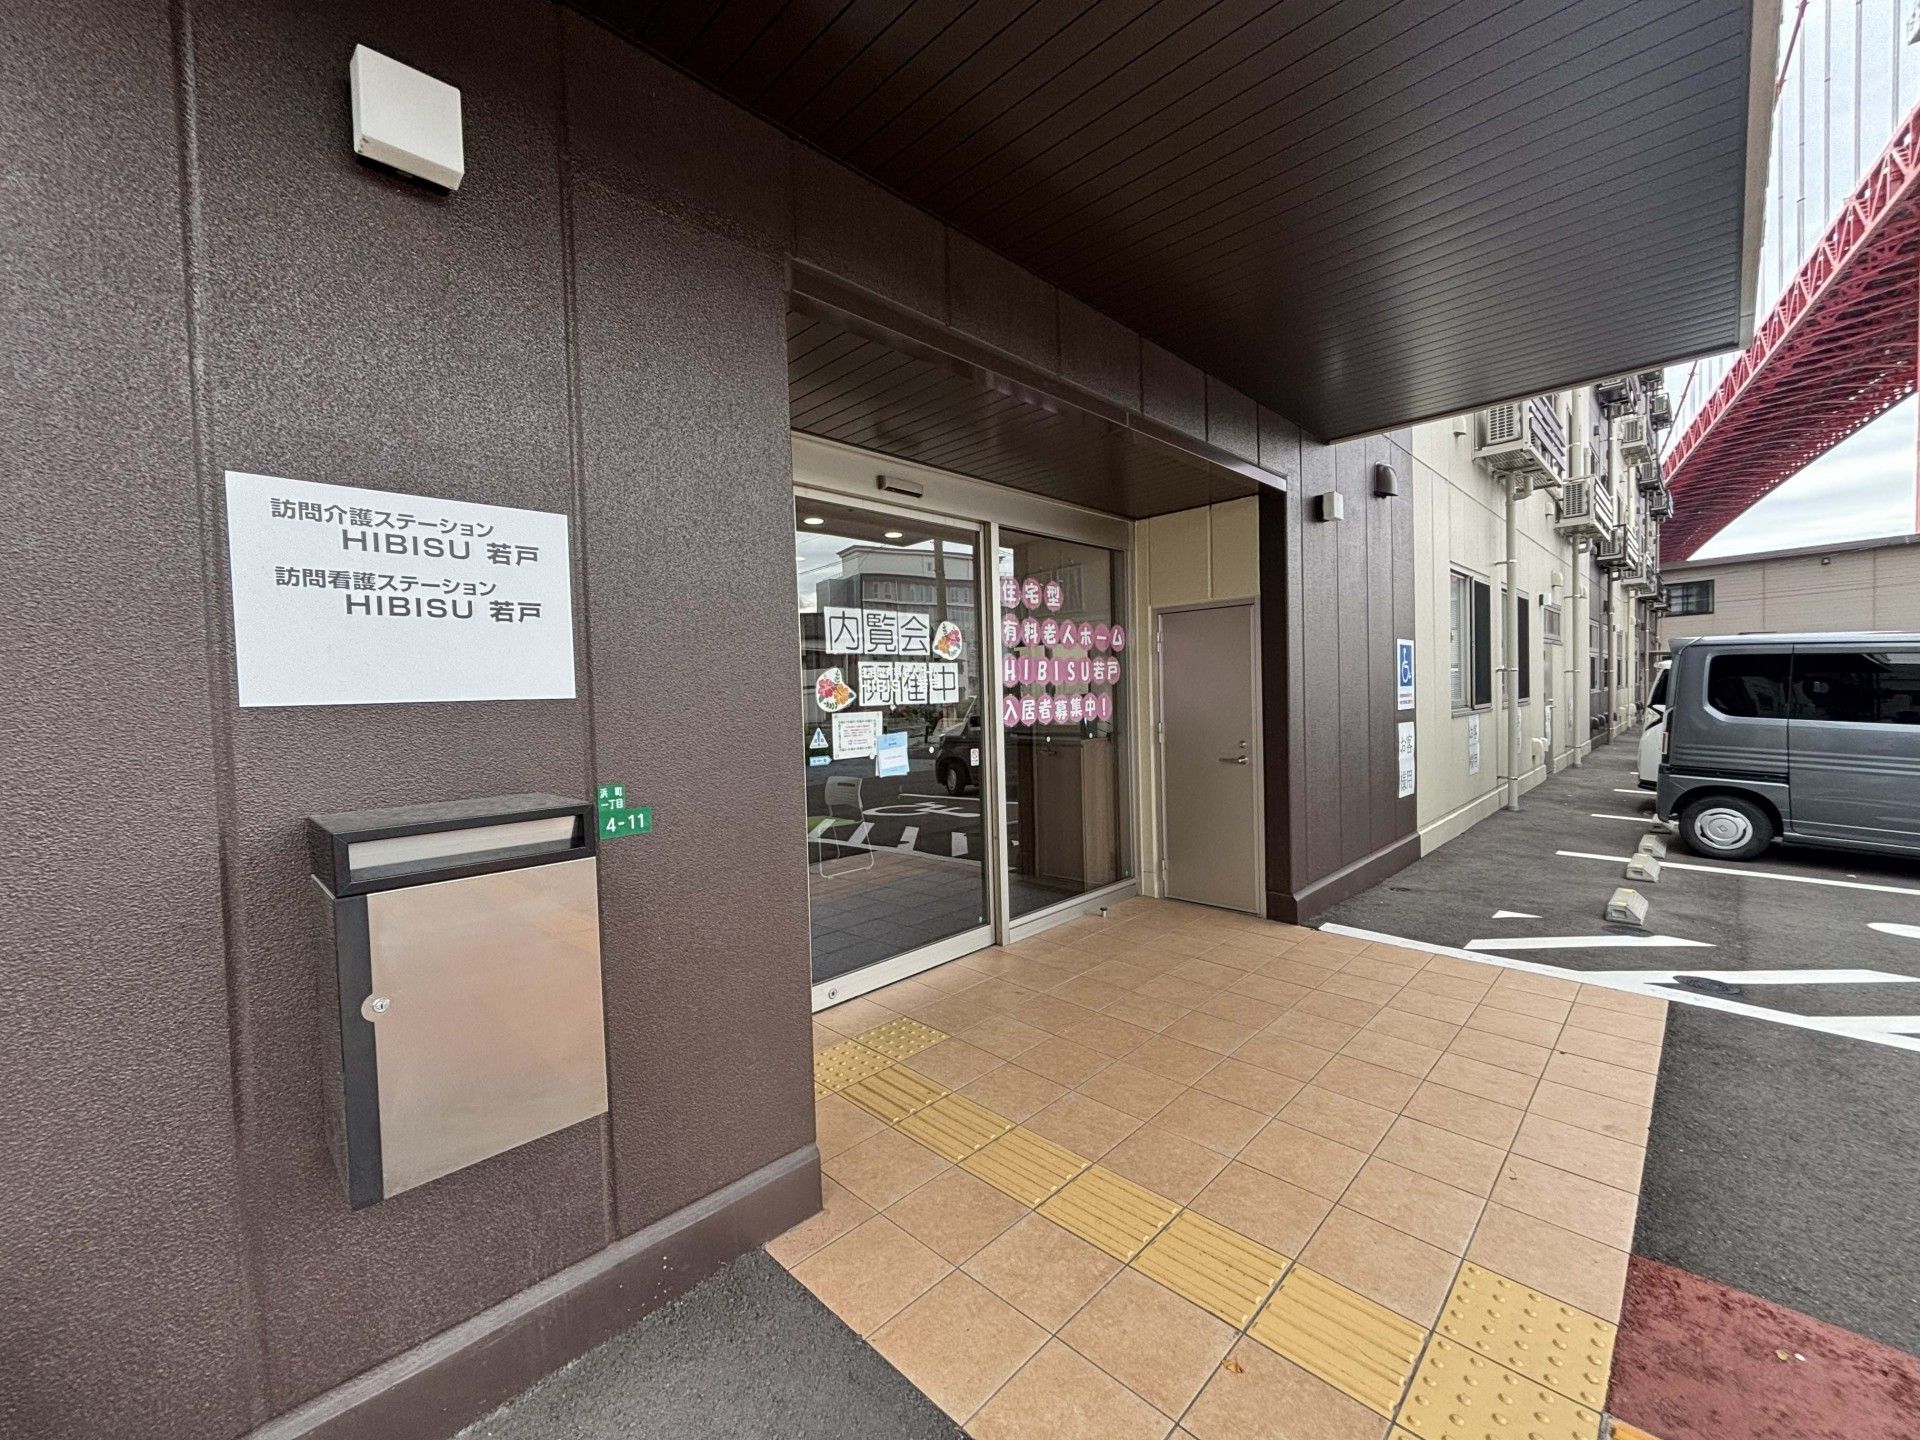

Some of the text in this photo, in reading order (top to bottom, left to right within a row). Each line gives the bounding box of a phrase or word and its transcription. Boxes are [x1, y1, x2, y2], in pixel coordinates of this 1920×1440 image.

[270, 497, 494, 537] 訪問介護ステーション
[341, 529, 539, 567] HIBISU 若戸
[274, 566, 497, 597] 訪問看護ステーション
[1002, 580, 1061, 607] 住宅型
[345, 594, 542, 623] HIBISU 若戸
[828, 610, 929, 653] 内覧会
[1003, 619, 1123, 646] 有料老人ホーム
[1004, 697, 1107, 721] 入居者募集中！
[600, 798, 624, 810] 一丁目
[605, 813, 645, 833] 4-11
